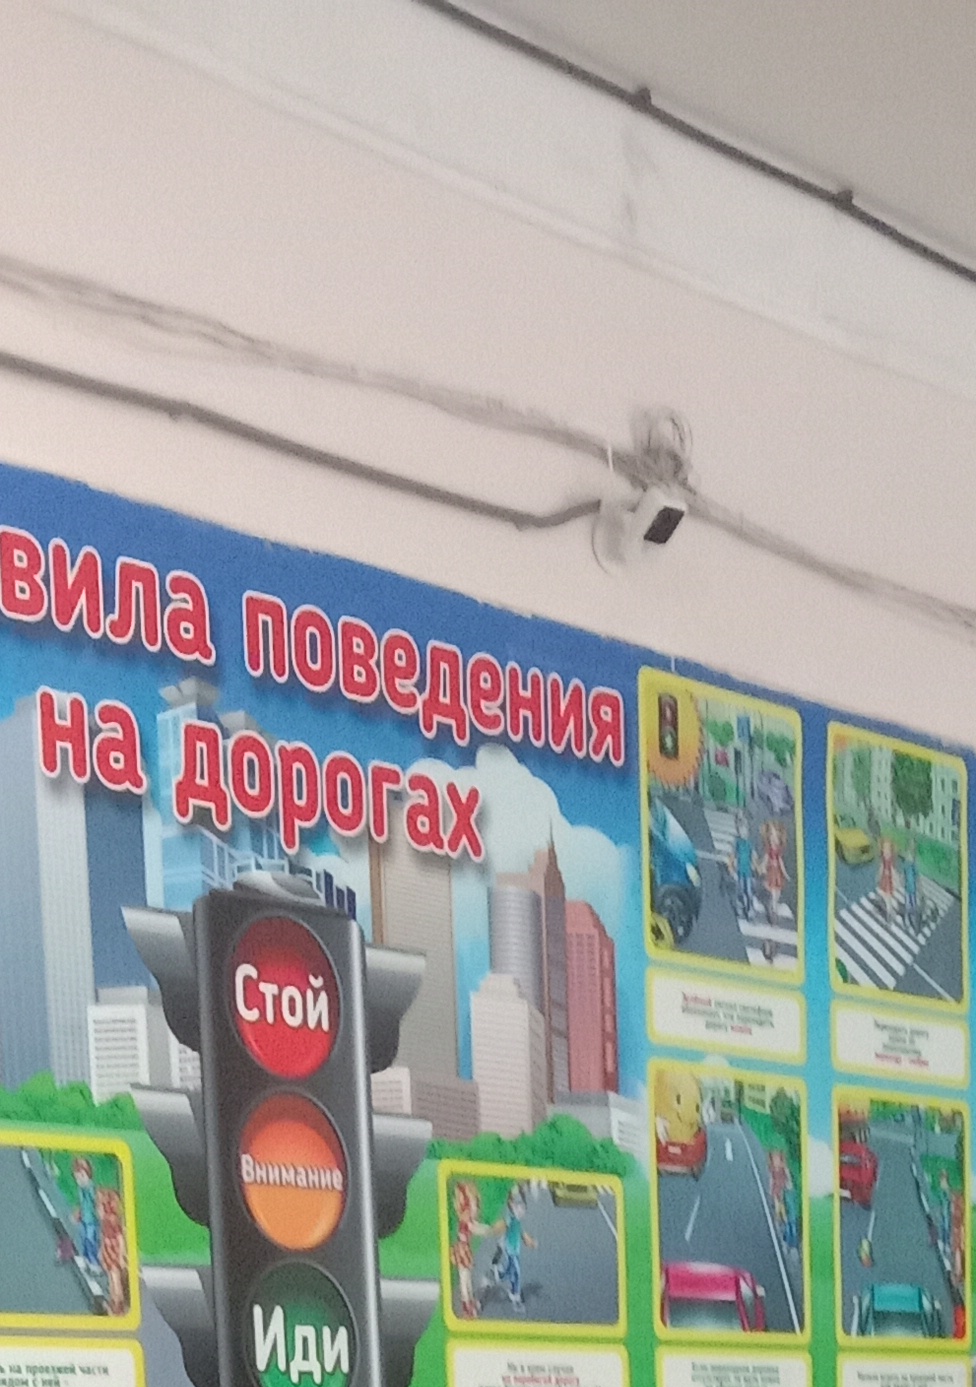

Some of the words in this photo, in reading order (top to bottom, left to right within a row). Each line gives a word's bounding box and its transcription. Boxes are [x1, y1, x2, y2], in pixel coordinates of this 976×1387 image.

[242, 590, 624, 766] поведения
[37, 686, 147, 794] на
[174, 722, 486, 861] дорогах
[234, 963, 330, 1032] Стой
[241, 1154, 344, 1191] Внимание
[253, 1304, 350, 1385] Иди
